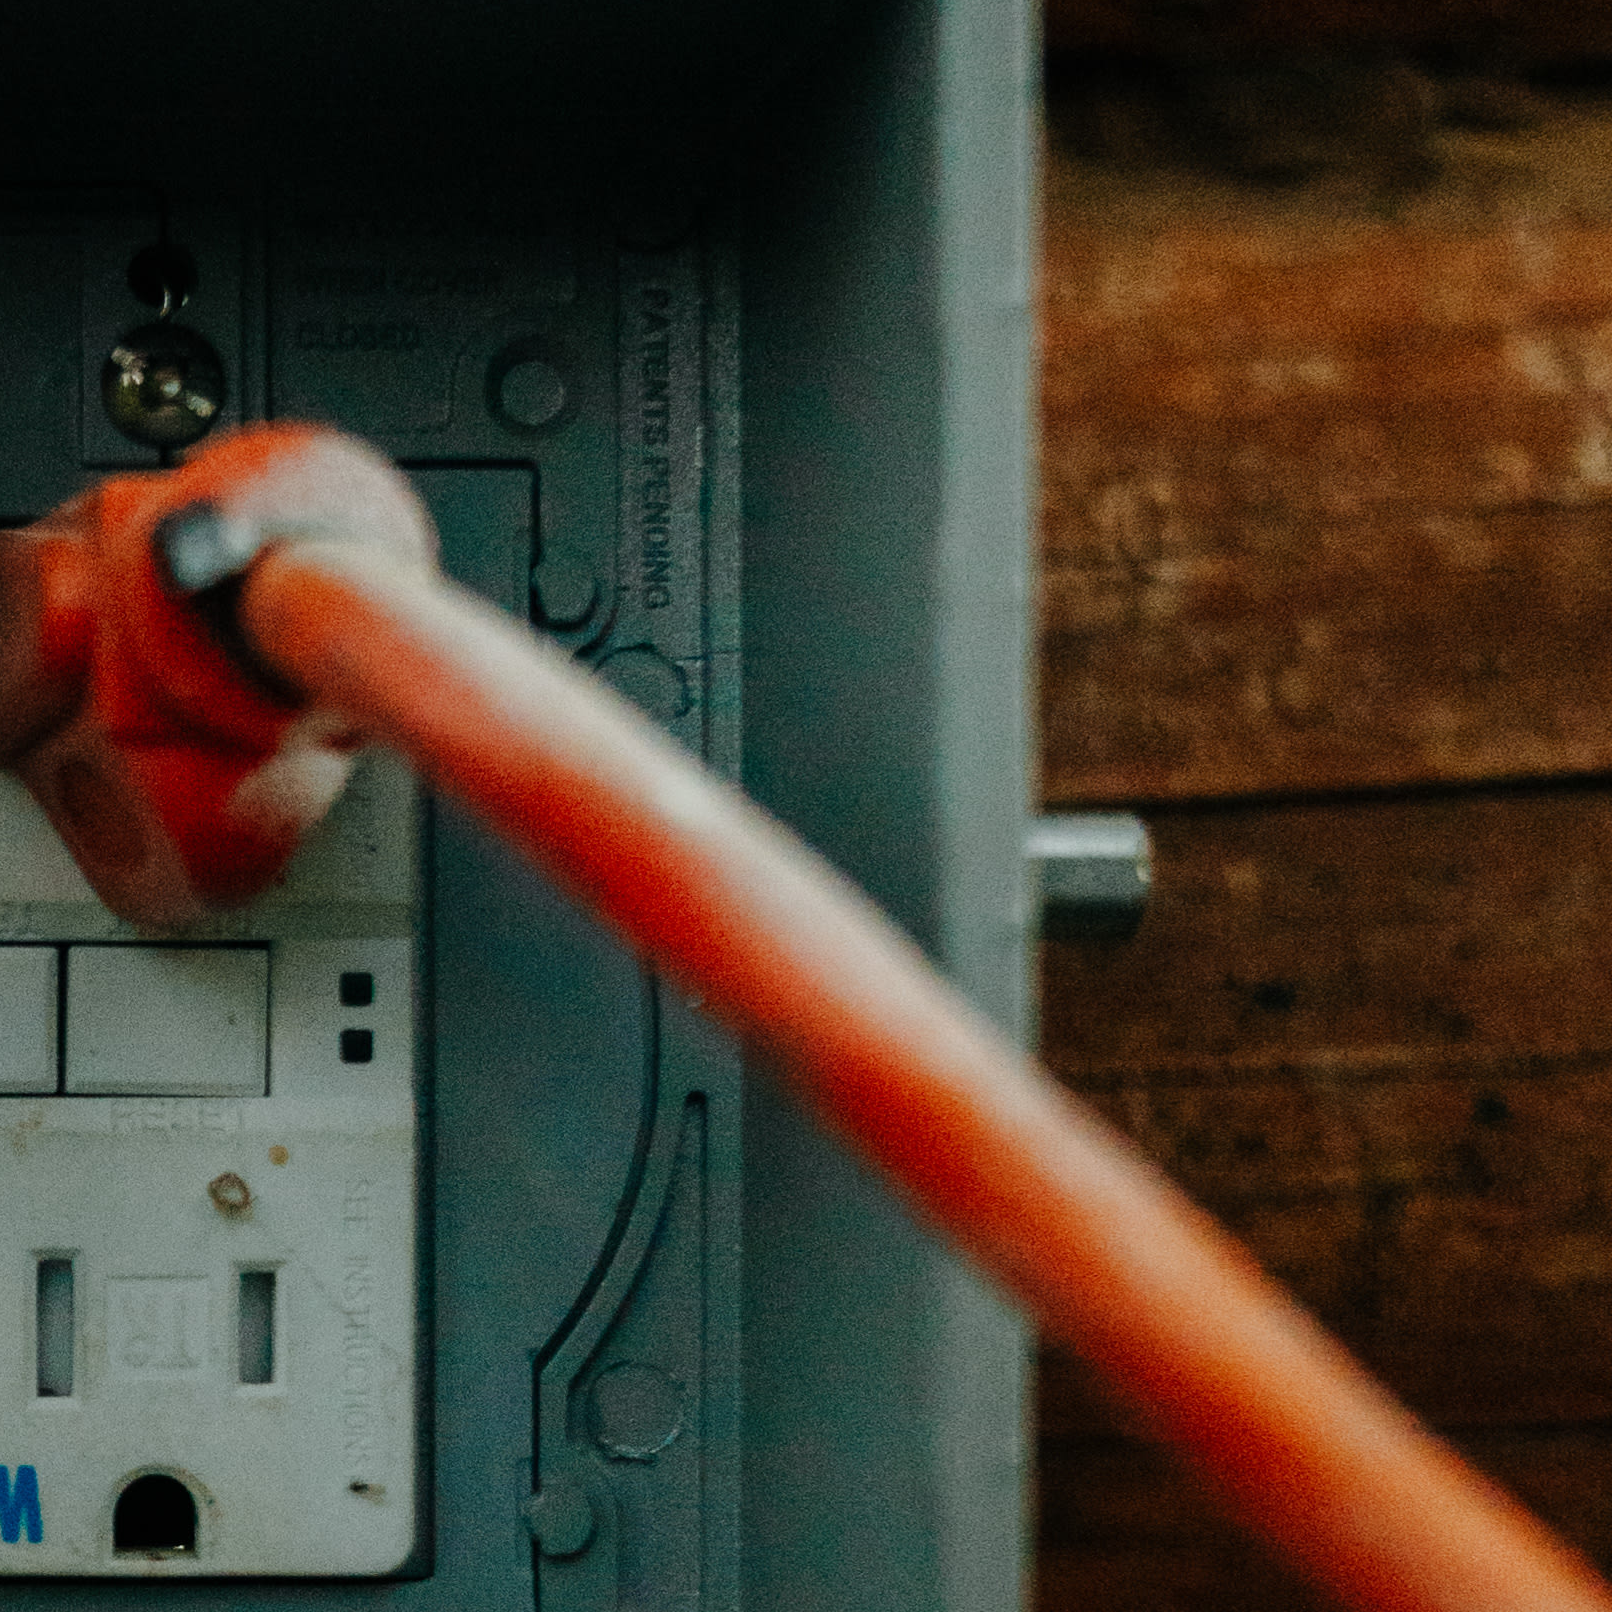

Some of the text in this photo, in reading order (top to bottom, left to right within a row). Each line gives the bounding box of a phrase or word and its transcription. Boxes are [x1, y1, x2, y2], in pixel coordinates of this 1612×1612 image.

[393, 267, 503, 297] COVER
[296, 321, 423, 351] CLOSED
[641, 286, 673, 610] PATENTS PENDING
